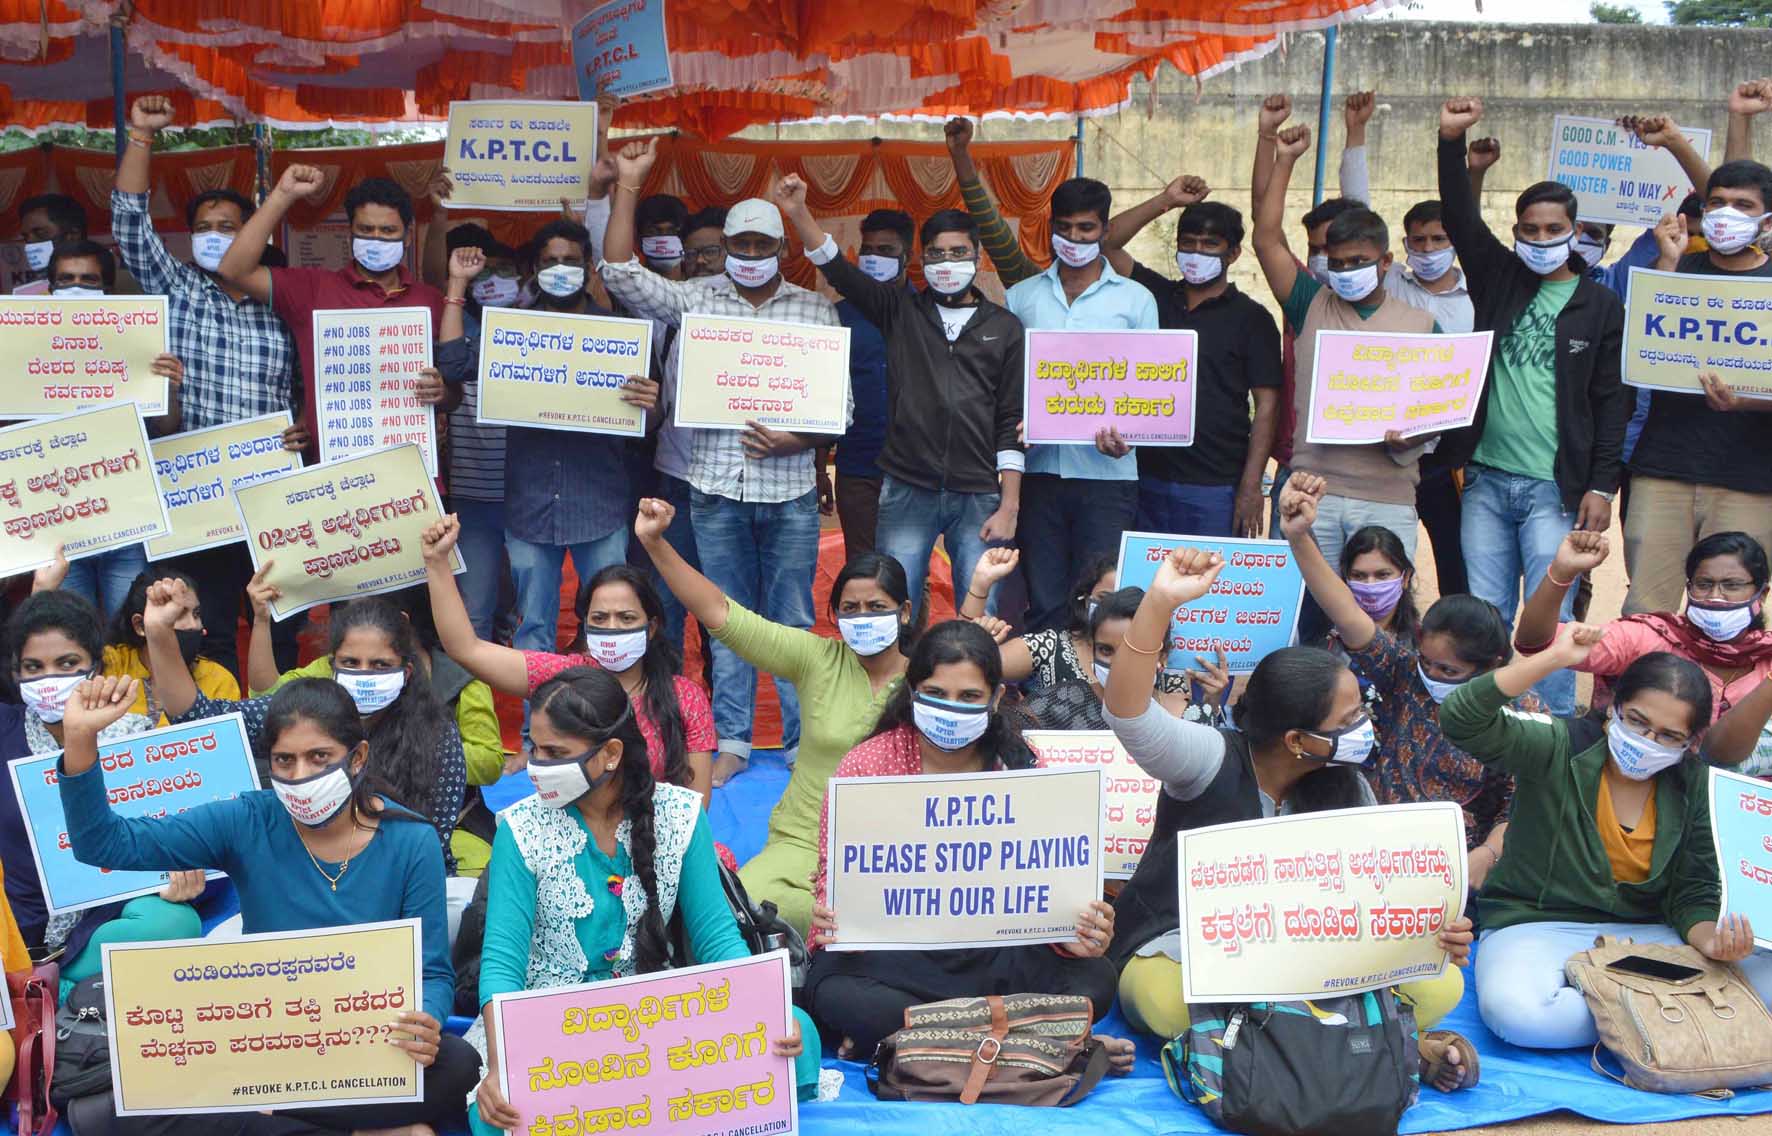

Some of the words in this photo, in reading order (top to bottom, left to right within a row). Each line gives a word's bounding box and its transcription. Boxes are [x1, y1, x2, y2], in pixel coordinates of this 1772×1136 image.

[1562, 126, 1592, 143] GOOD
[1596, 129, 1616, 146] C.M
[460, 138, 577, 162] K.P.T.C.L
[1559, 150, 1590, 168] GOOD
[1592, 153, 1632, 172] POWER
[1619, 180, 1634, 197] NO
[1638, 181, 1661, 199] WAY
[72, 308, 159, 334] ಉದ್ಯೋಗದ
[323, 327, 344, 338] #NO
[347, 326, 370, 338] JOBS
[379, 325, 399, 337] #NO
[401, 324, 424, 336] VOTE
[1645, 313, 1772, 346] K.P.T.C.
[493, 328, 573, 357] ವಿದ್ಯಾರ್ಥಿಗಳ
[582, 336, 640, 357] ಬಲಿದಾನ
[690, 328, 753, 343] ಯುವಕರ
[324, 345, 344, 357] #NO
[347, 344, 371, 356] JOBS
[380, 344, 400, 356] #NO
[402, 343, 424, 355] VOTE
[28, 358, 76, 375] ದೇಶದ
[84, 359, 128, 382] ಭವಿಷ್ಯ
[324, 363, 345, 375] #NO
[347, 362, 371, 374] JOBS
[380, 362, 400, 374] #NO
[489, 361, 568, 385] ನಿಗಮಗಳಿಗೆ
[716, 371, 760, 388] ದೇಶದ
[1036, 358, 1128, 390] ವಿದ್ಯಾರ್ಥಿಗಳ
[44, 384, 114, 399] ಸರ್ವನಾಶ
[325, 381, 345, 393] #NO
[348, 380, 371, 392] JOBS
[380, 380, 400, 392] #NO
[403, 379, 416, 391] VO
[326, 399, 346, 411] #NO
[349, 398, 372, 410] JOBS
[381, 397, 400, 409] #NO
[728, 397, 793, 412] ಸರ್ವನಾಶ
[1046, 393, 1105, 415] ಕುರುಡು
[1114, 392, 1175, 417] ಸರ್ಕಾರ
[328, 418, 347, 430] #NO
[350, 417, 373, 429] JOBS
[382, 416, 401, 427] #NO
[403, 414, 426, 426] VOTE
[592, 415, 635, 427] CANCELLATION
[329, 436, 349, 448] #NO
[352, 435, 374, 447] JOBS
[383, 433, 402, 446] #NO
[27, 448, 140, 497] ಅಭ್ಯರ್ಥಿಗಳಿಗೆ
[4, 496, 110, 539] ಪ್ರಾಣಸಂಕಟ
[321, 489, 429, 539] ಅಭ್ಯರ್ಥಿಗಳಿಗೆ
[63, 540, 87, 552] REVOKE
[113, 523, 158, 539] CANCELLATION
[303, 536, 402, 578] ಪ್ರಾಣಸಂಕಟ
[1230, 551, 1287, 568] ನಿರ್ಧಾರ
[1236, 609, 1281, 625] ಜೀವನ
[145, 732, 217, 764] ನಿರ್ಧಾರ
[925, 794, 1016, 828] K.P.T.C.L
[843, 843, 927, 874] PLEASE
[935, 841, 992, 873] STOP
[1000, 834, 1090, 871] PLAYING
[1349, 846, 1454, 889] ಅಭ್ಯರ್ಥಿಗಳನ್ನು
[884, 887, 941, 917] WITH
[950, 886, 996, 917] OUR
[1003, 884, 1050, 914] LIFE
[996, 927, 1022, 935] #REVOKE
[1201, 902, 1273, 952] ಕತ್ತಲೆಗೆ
[1284, 903, 1360, 938] ದೂಡಿದ
[1370, 899, 1447, 938] ಸರ್ಕಾರ
[174, 952, 356, 982] ಯಡಿಯೂರಪ್ಪನವರೇ
[1324, 977, 1359, 988] #REVOKE
[1389, 963, 1438, 980] CANCELLATION
[126, 1006, 185, 1033] ಕೊಟ್ಟ
[197, 997, 273, 1023] ಮಾತಿಗೆ
[286, 997, 321, 1023] ತಪ್ಪಿ
[335, 987, 405, 1014] ನಡೆದರೆ
[562, 978, 731, 1041] ವಿದ್ಯಾರ್ಥಿಗಳ
[140, 1037, 217, 1066] ಮೆಚ್ಚನಾ
[230, 1023, 392, 1056] ಪರಮಾತ್ಮನು???
[528, 1044, 650, 1092] ನೋವಿನ
[667, 1022, 767, 1070] ಕೂಗಿಗೆ
[232, 1082, 282, 1096] #REVOKE
[285, 1079, 327, 1093] K.P.T.C.L
[331, 1077, 406, 1090] CANCELLATION
[668, 1072, 775, 1122] ಸರ್ಕಾರ
[728, 1119, 787, 1136] CANCELLATION
